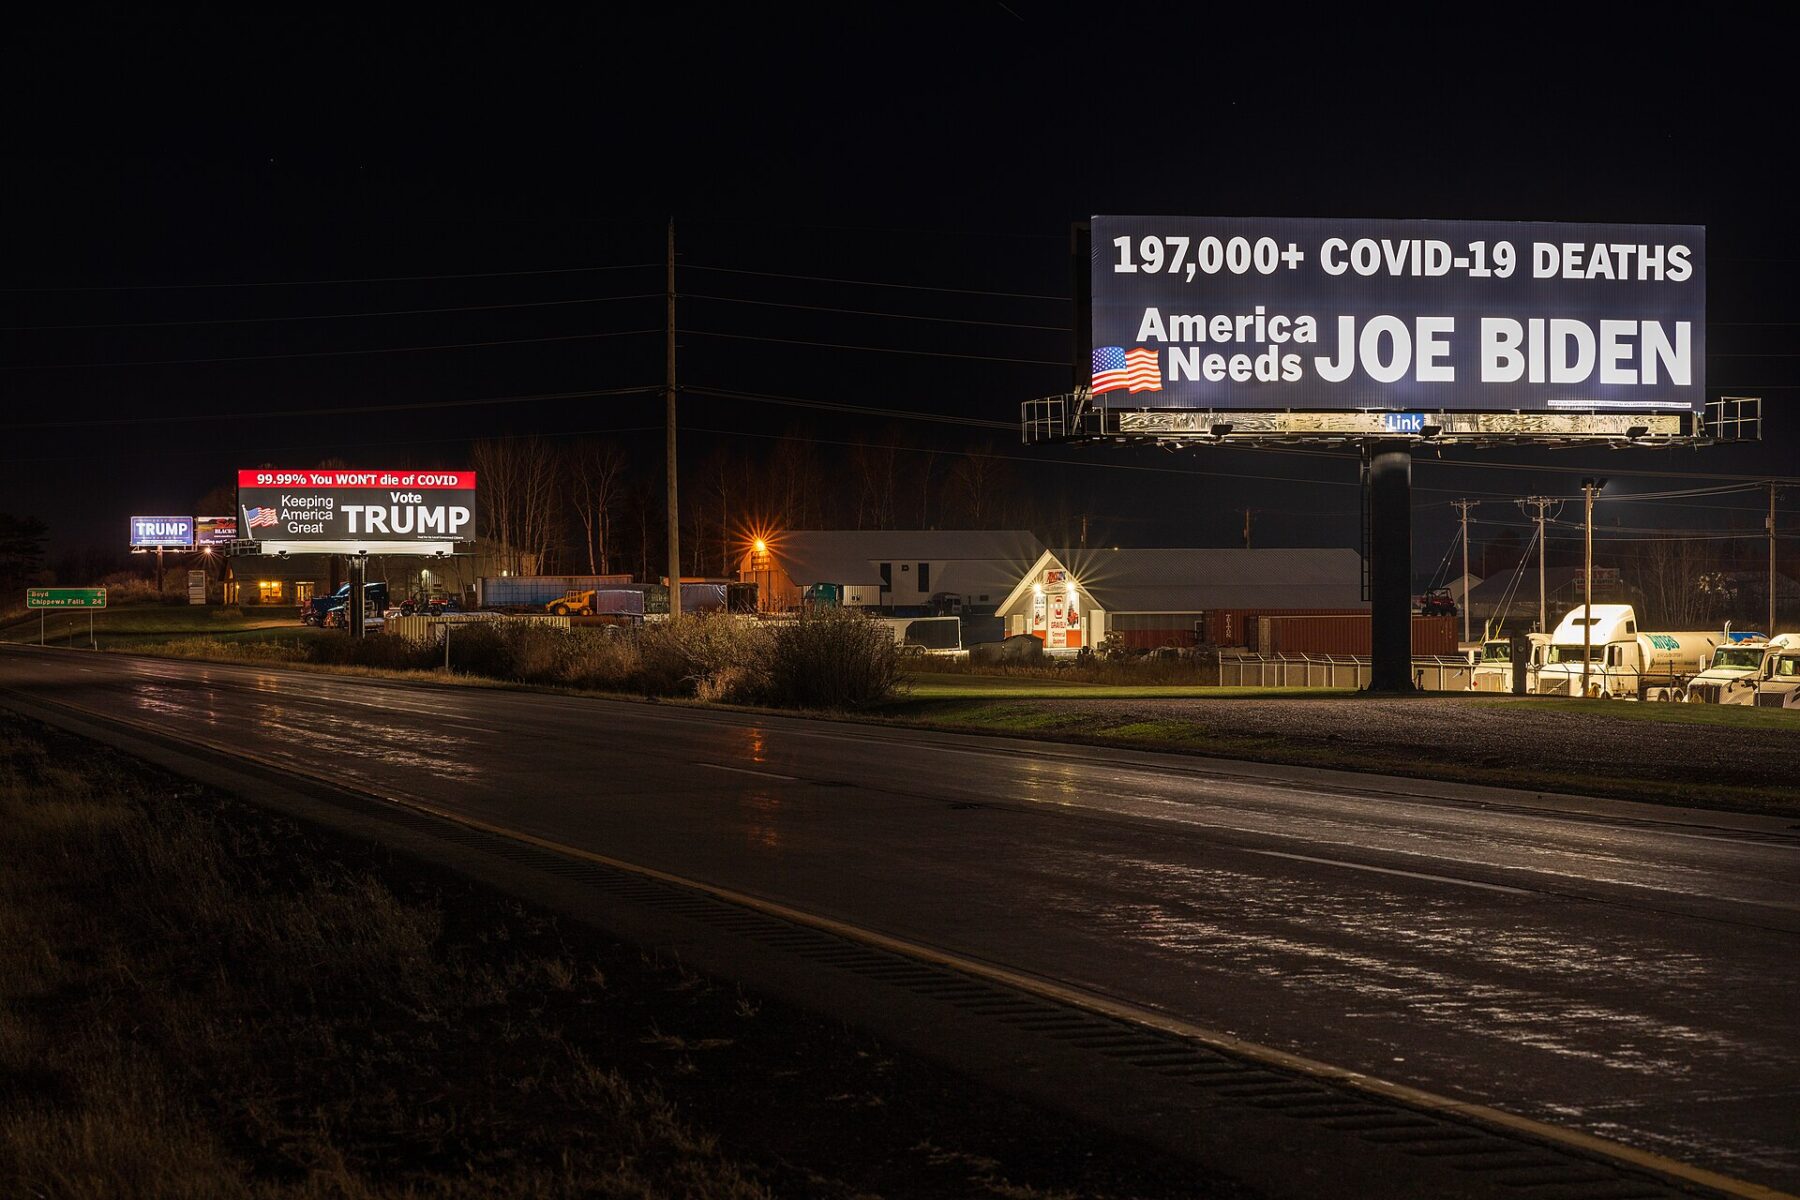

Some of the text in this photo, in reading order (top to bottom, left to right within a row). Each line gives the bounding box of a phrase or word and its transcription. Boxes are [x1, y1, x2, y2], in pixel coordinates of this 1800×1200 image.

[1113, 235, 1693, 283] 197,000+ COVID-19 DEATHS
[1136, 305, 1317, 343] America
[1314, 315, 1692, 386] JOE BIDEN
[1168, 344, 1303, 382] Needs
[1388, 414, 1421, 430] Link
[257, 474, 458, 486] 99.99% You WON'T die of COVID
[281, 494, 334, 509] Keeping
[390, 491, 422, 504] Vote
[281, 508, 333, 521] America
[340, 505, 471, 534] TRUMP
[136, 522, 188, 536] TRUMP
[287, 521, 324, 534] Great
[1645, 634, 1680, 651] Airgas
